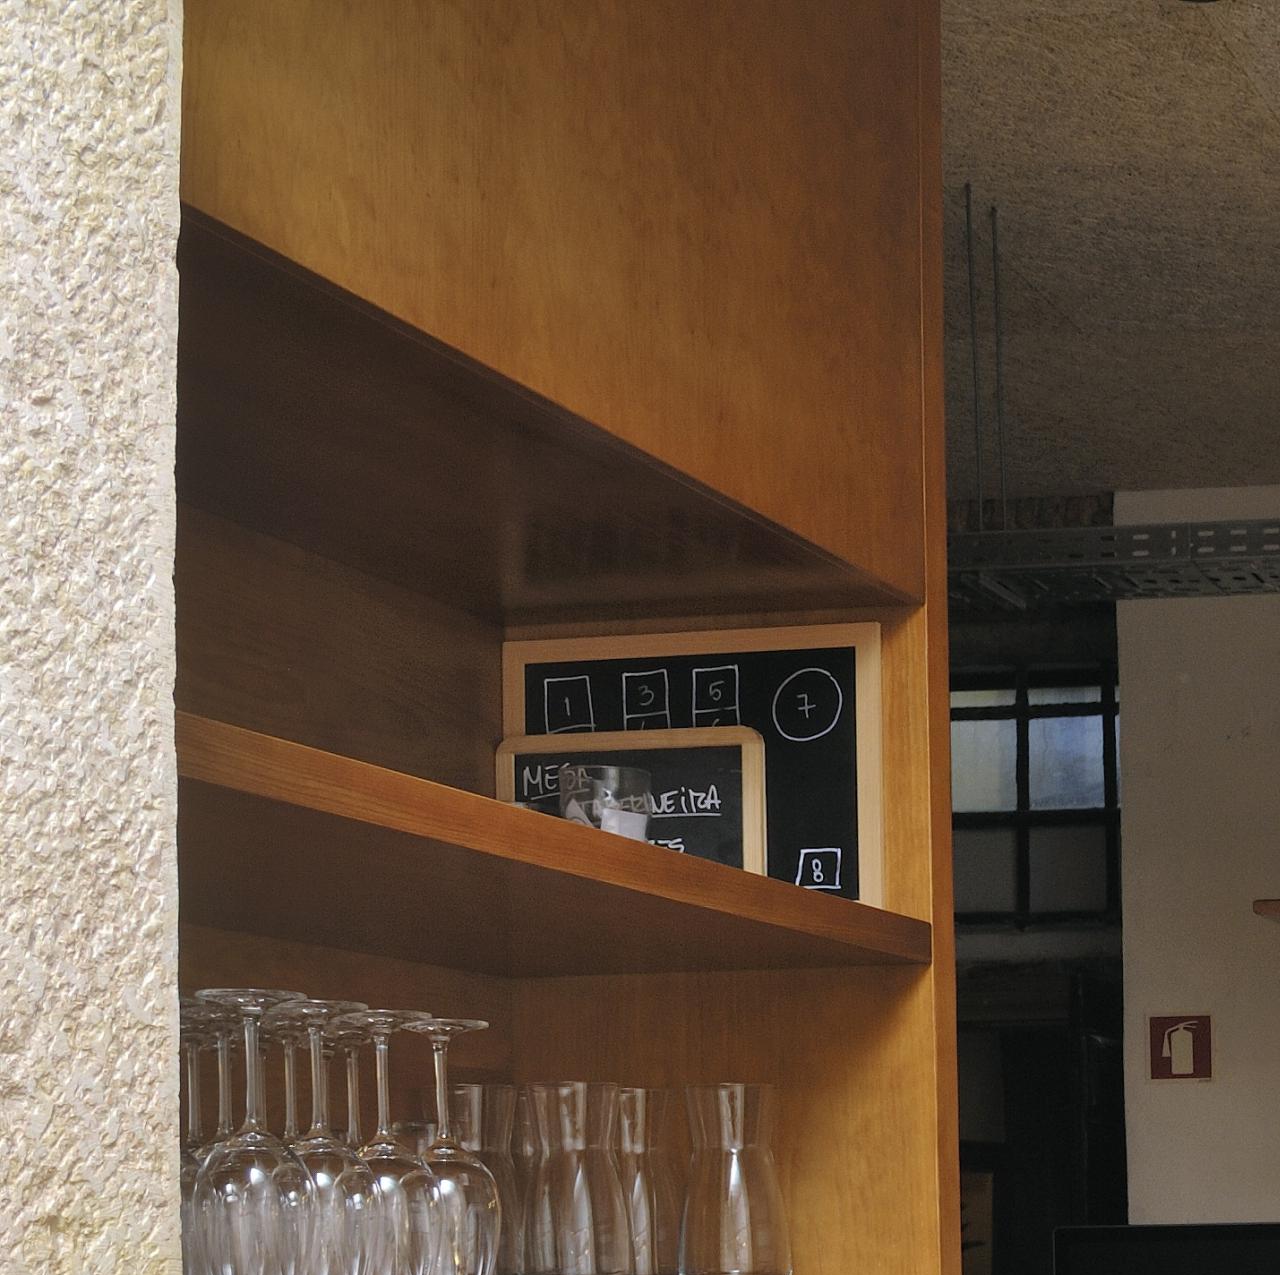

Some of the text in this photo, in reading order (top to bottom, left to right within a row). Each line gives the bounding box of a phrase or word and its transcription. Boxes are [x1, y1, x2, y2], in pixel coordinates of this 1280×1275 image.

[563, 680, 816, 719] 1 3 5 7
[812, 859, 824, 883] 8
